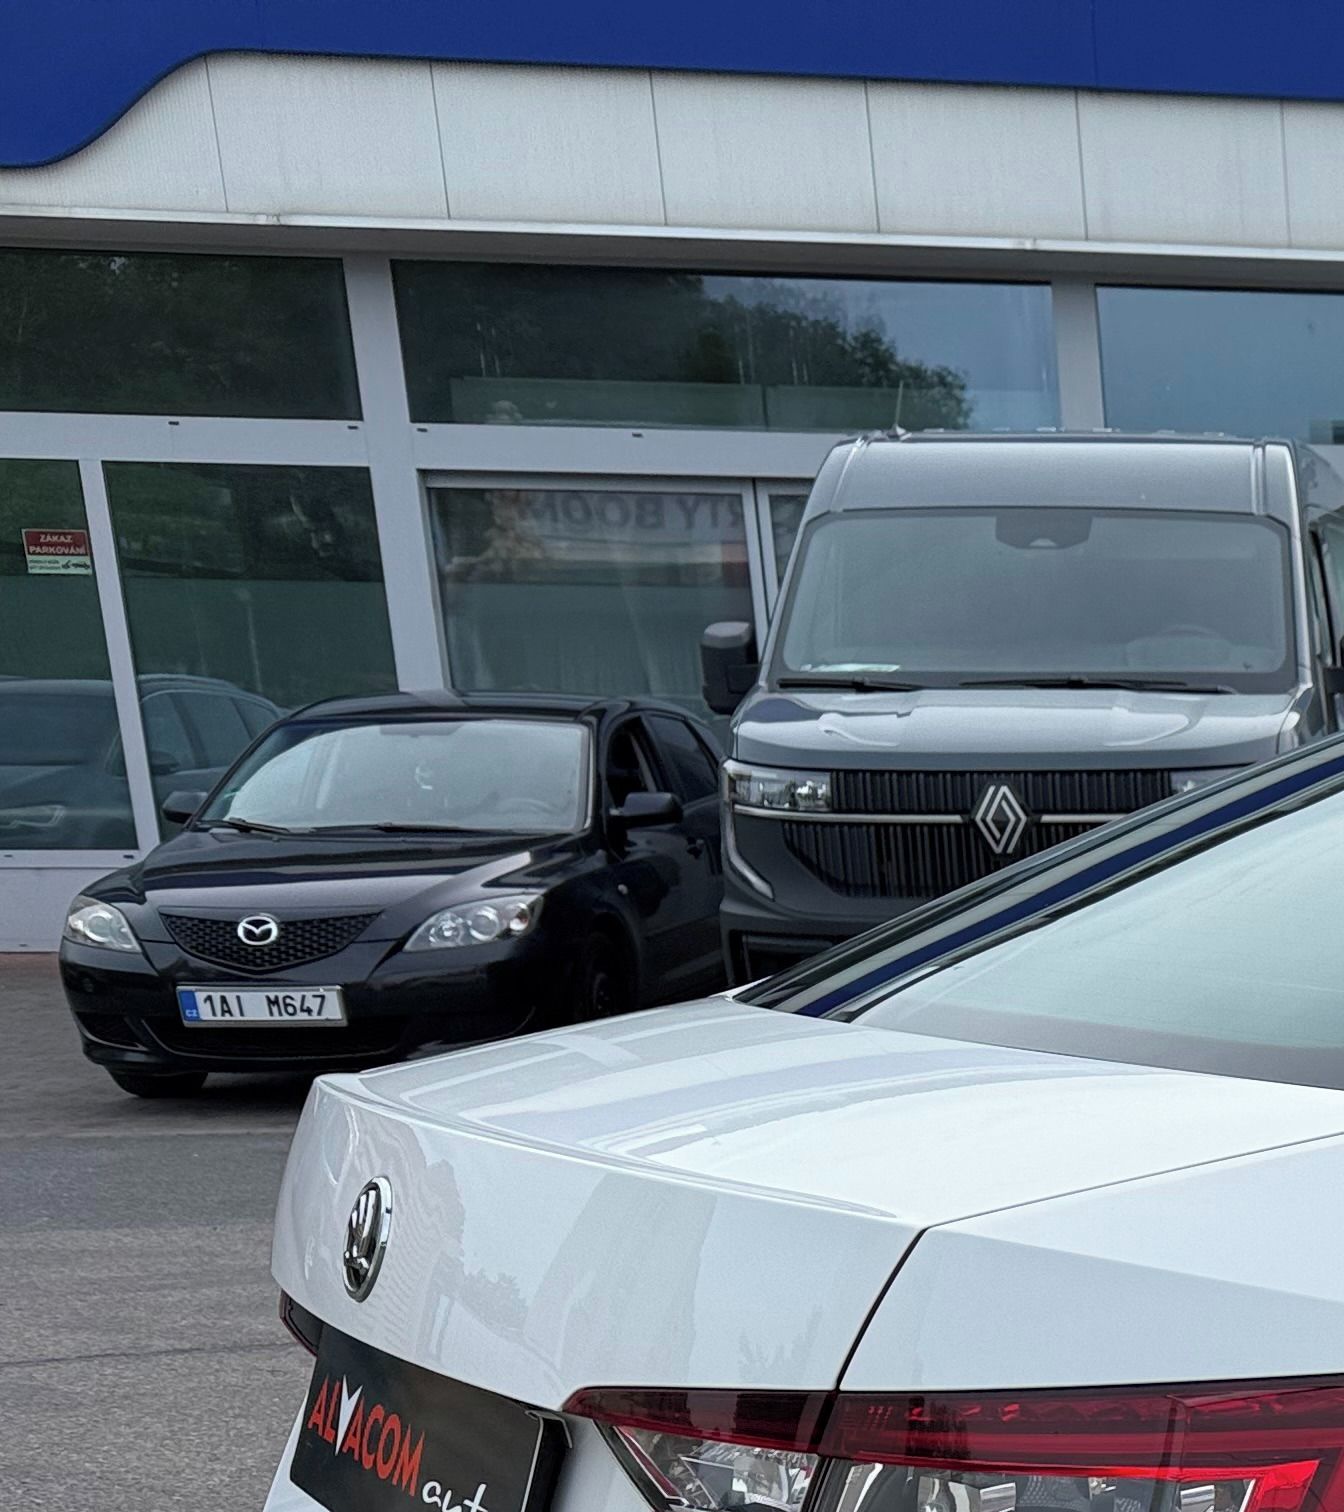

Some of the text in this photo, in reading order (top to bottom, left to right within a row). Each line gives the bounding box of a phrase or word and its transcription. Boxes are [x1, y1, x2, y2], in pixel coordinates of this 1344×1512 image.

[203, 994, 327, 1018] 1AI M647
[307, 1374, 426, 1496] ALVACOM
